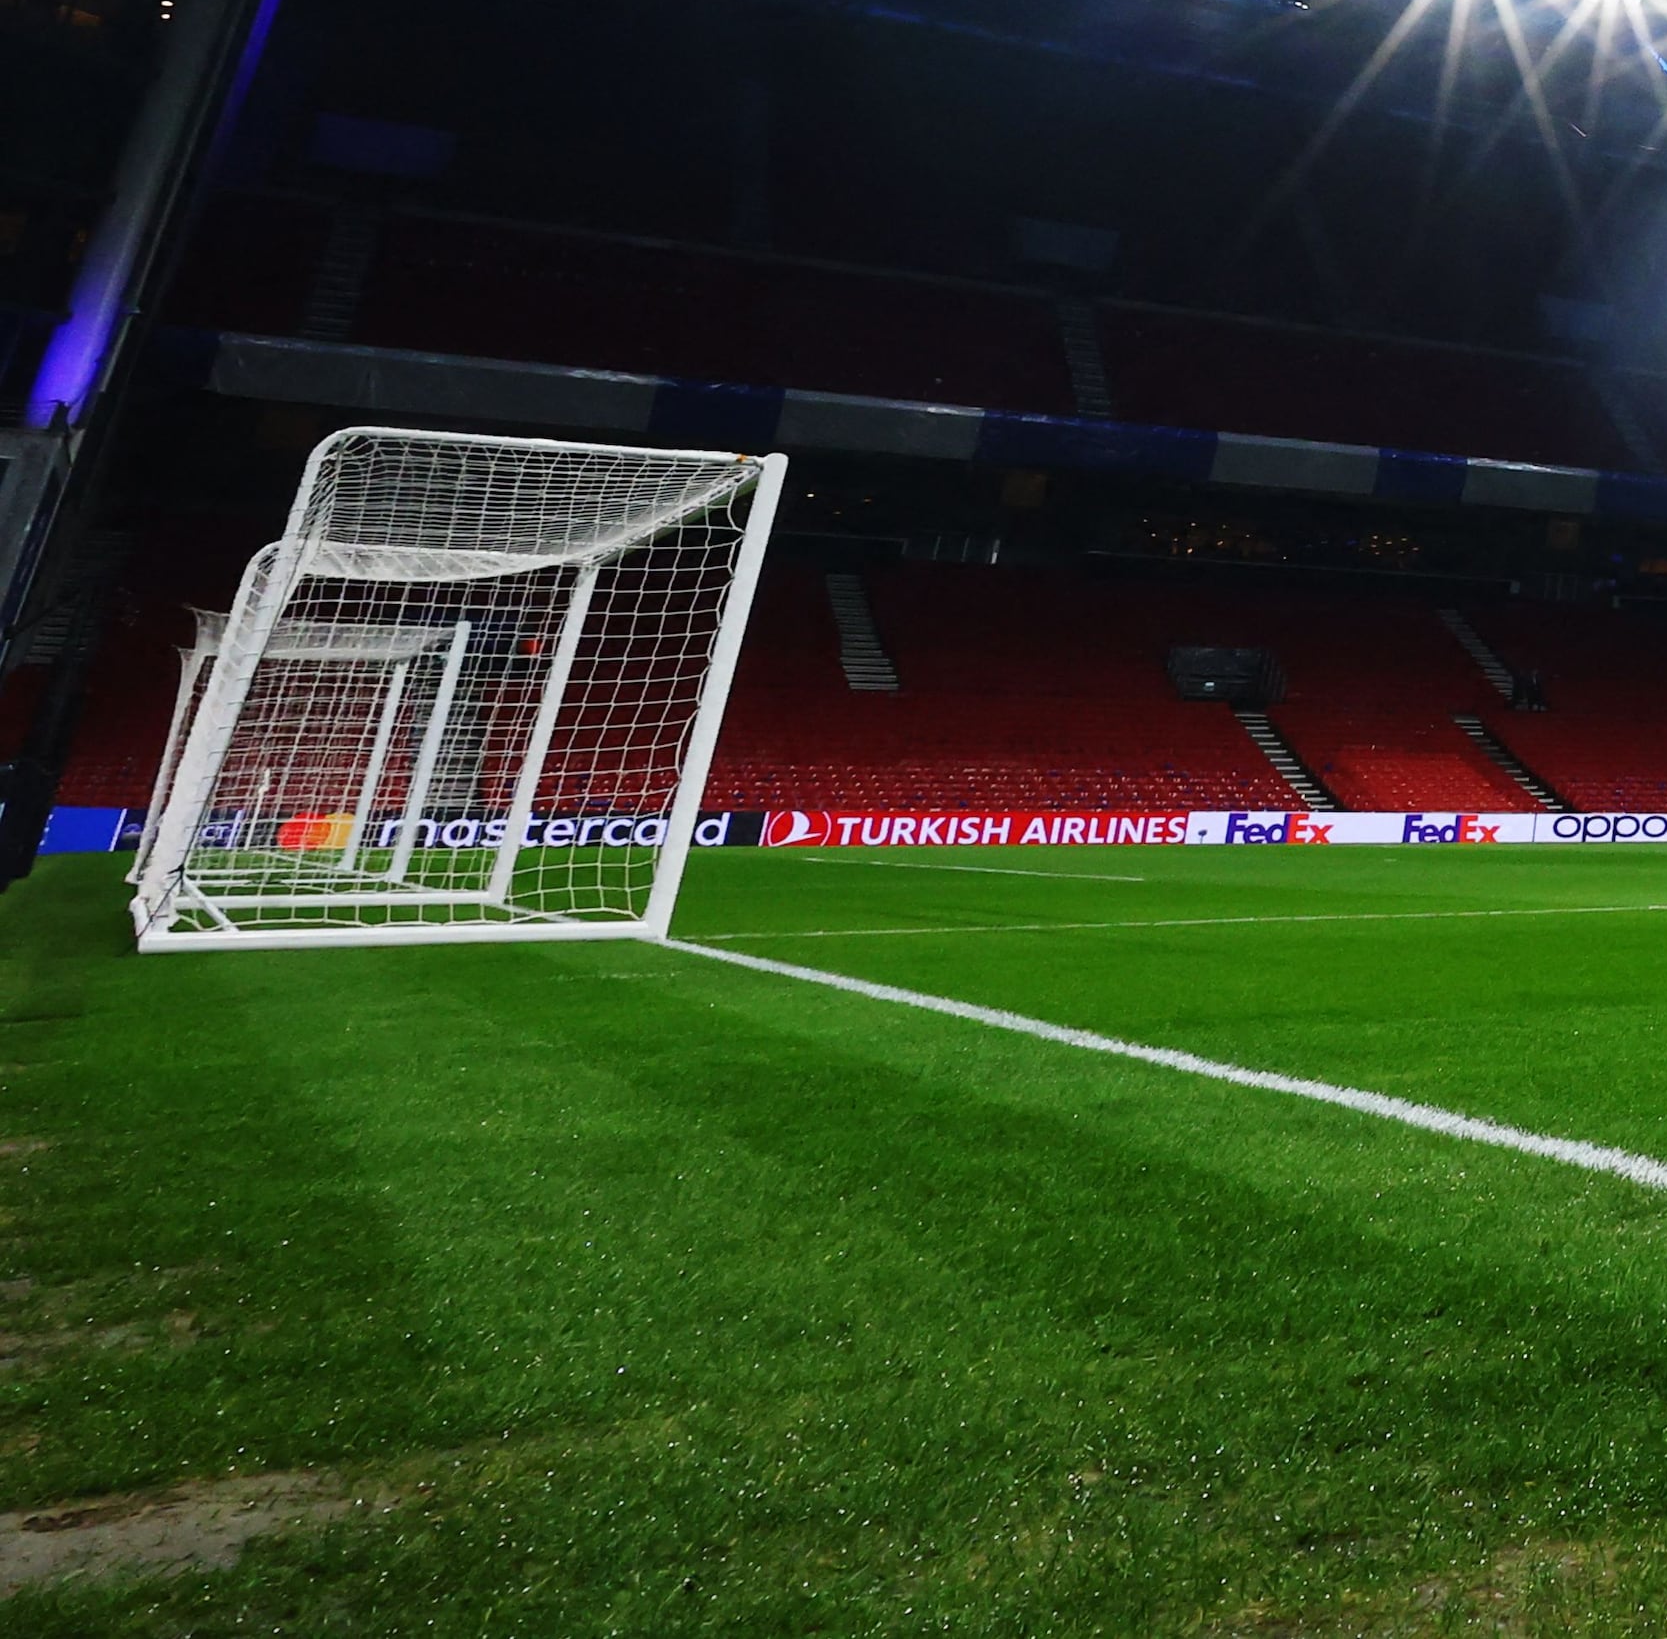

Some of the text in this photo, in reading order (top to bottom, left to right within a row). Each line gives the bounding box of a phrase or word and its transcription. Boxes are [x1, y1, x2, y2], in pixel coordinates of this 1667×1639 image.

[378, 811, 730, 847] mastercad
[837, 816, 1187, 845] TURKISH AIRLINES
[1226, 813, 1334, 844] FedEx
[1402, 814, 1500, 844] FedEx
